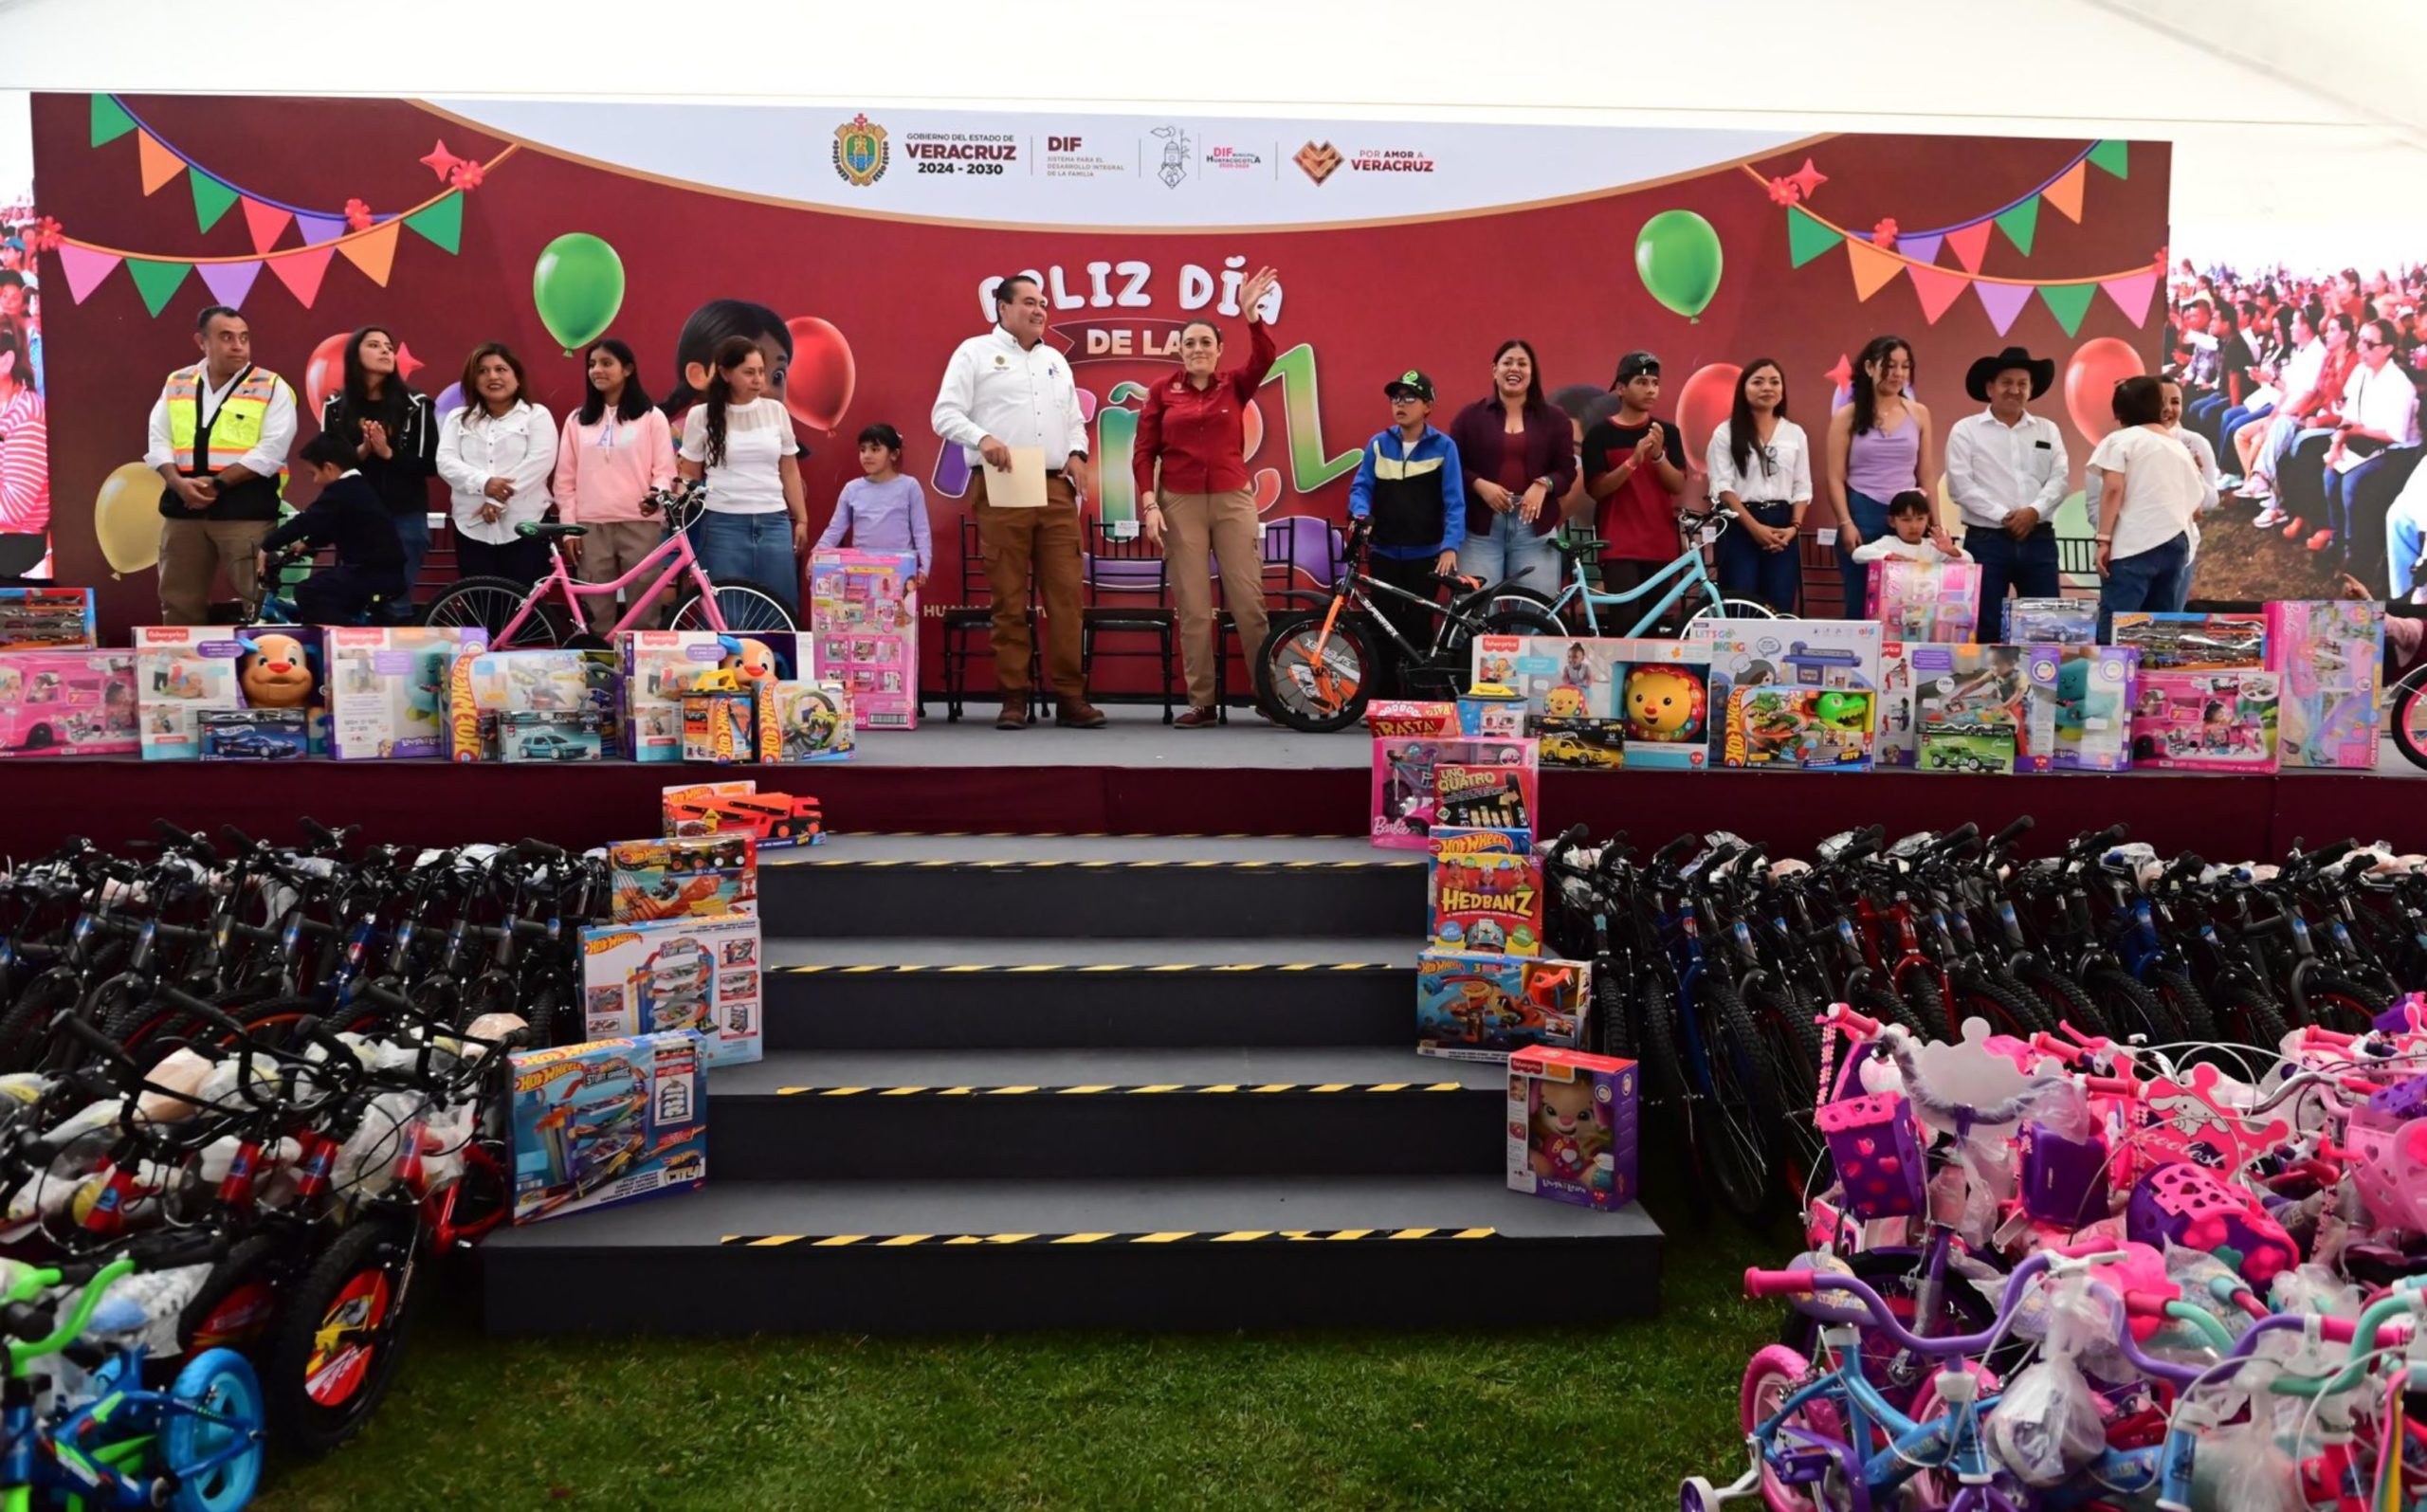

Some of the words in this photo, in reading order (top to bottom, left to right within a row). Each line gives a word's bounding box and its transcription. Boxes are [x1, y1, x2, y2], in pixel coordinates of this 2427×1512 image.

[906, 133, 950, 141] GOBIERNO
[1048, 137, 1083, 152] DIF
[905, 143, 1017, 161] VERACRUZ
[1214, 147, 1232, 157] DIF
[1359, 150, 1380, 158] POR
[917, 162, 955, 173] 2024
[966, 163, 1004, 175] 2030
[1351, 159, 1433, 173] VERACRUZ
[977, 261, 1152, 323] FLIZ
[1087, 329, 1133, 355] DE
[1143, 329, 1182, 355] LA
[1439, 768, 1466, 780] UNO
[1436, 772, 1496, 792] QUATRO
[1374, 816, 1412, 835] Barbie
[1440, 887, 1535, 917] HEDBANZ
